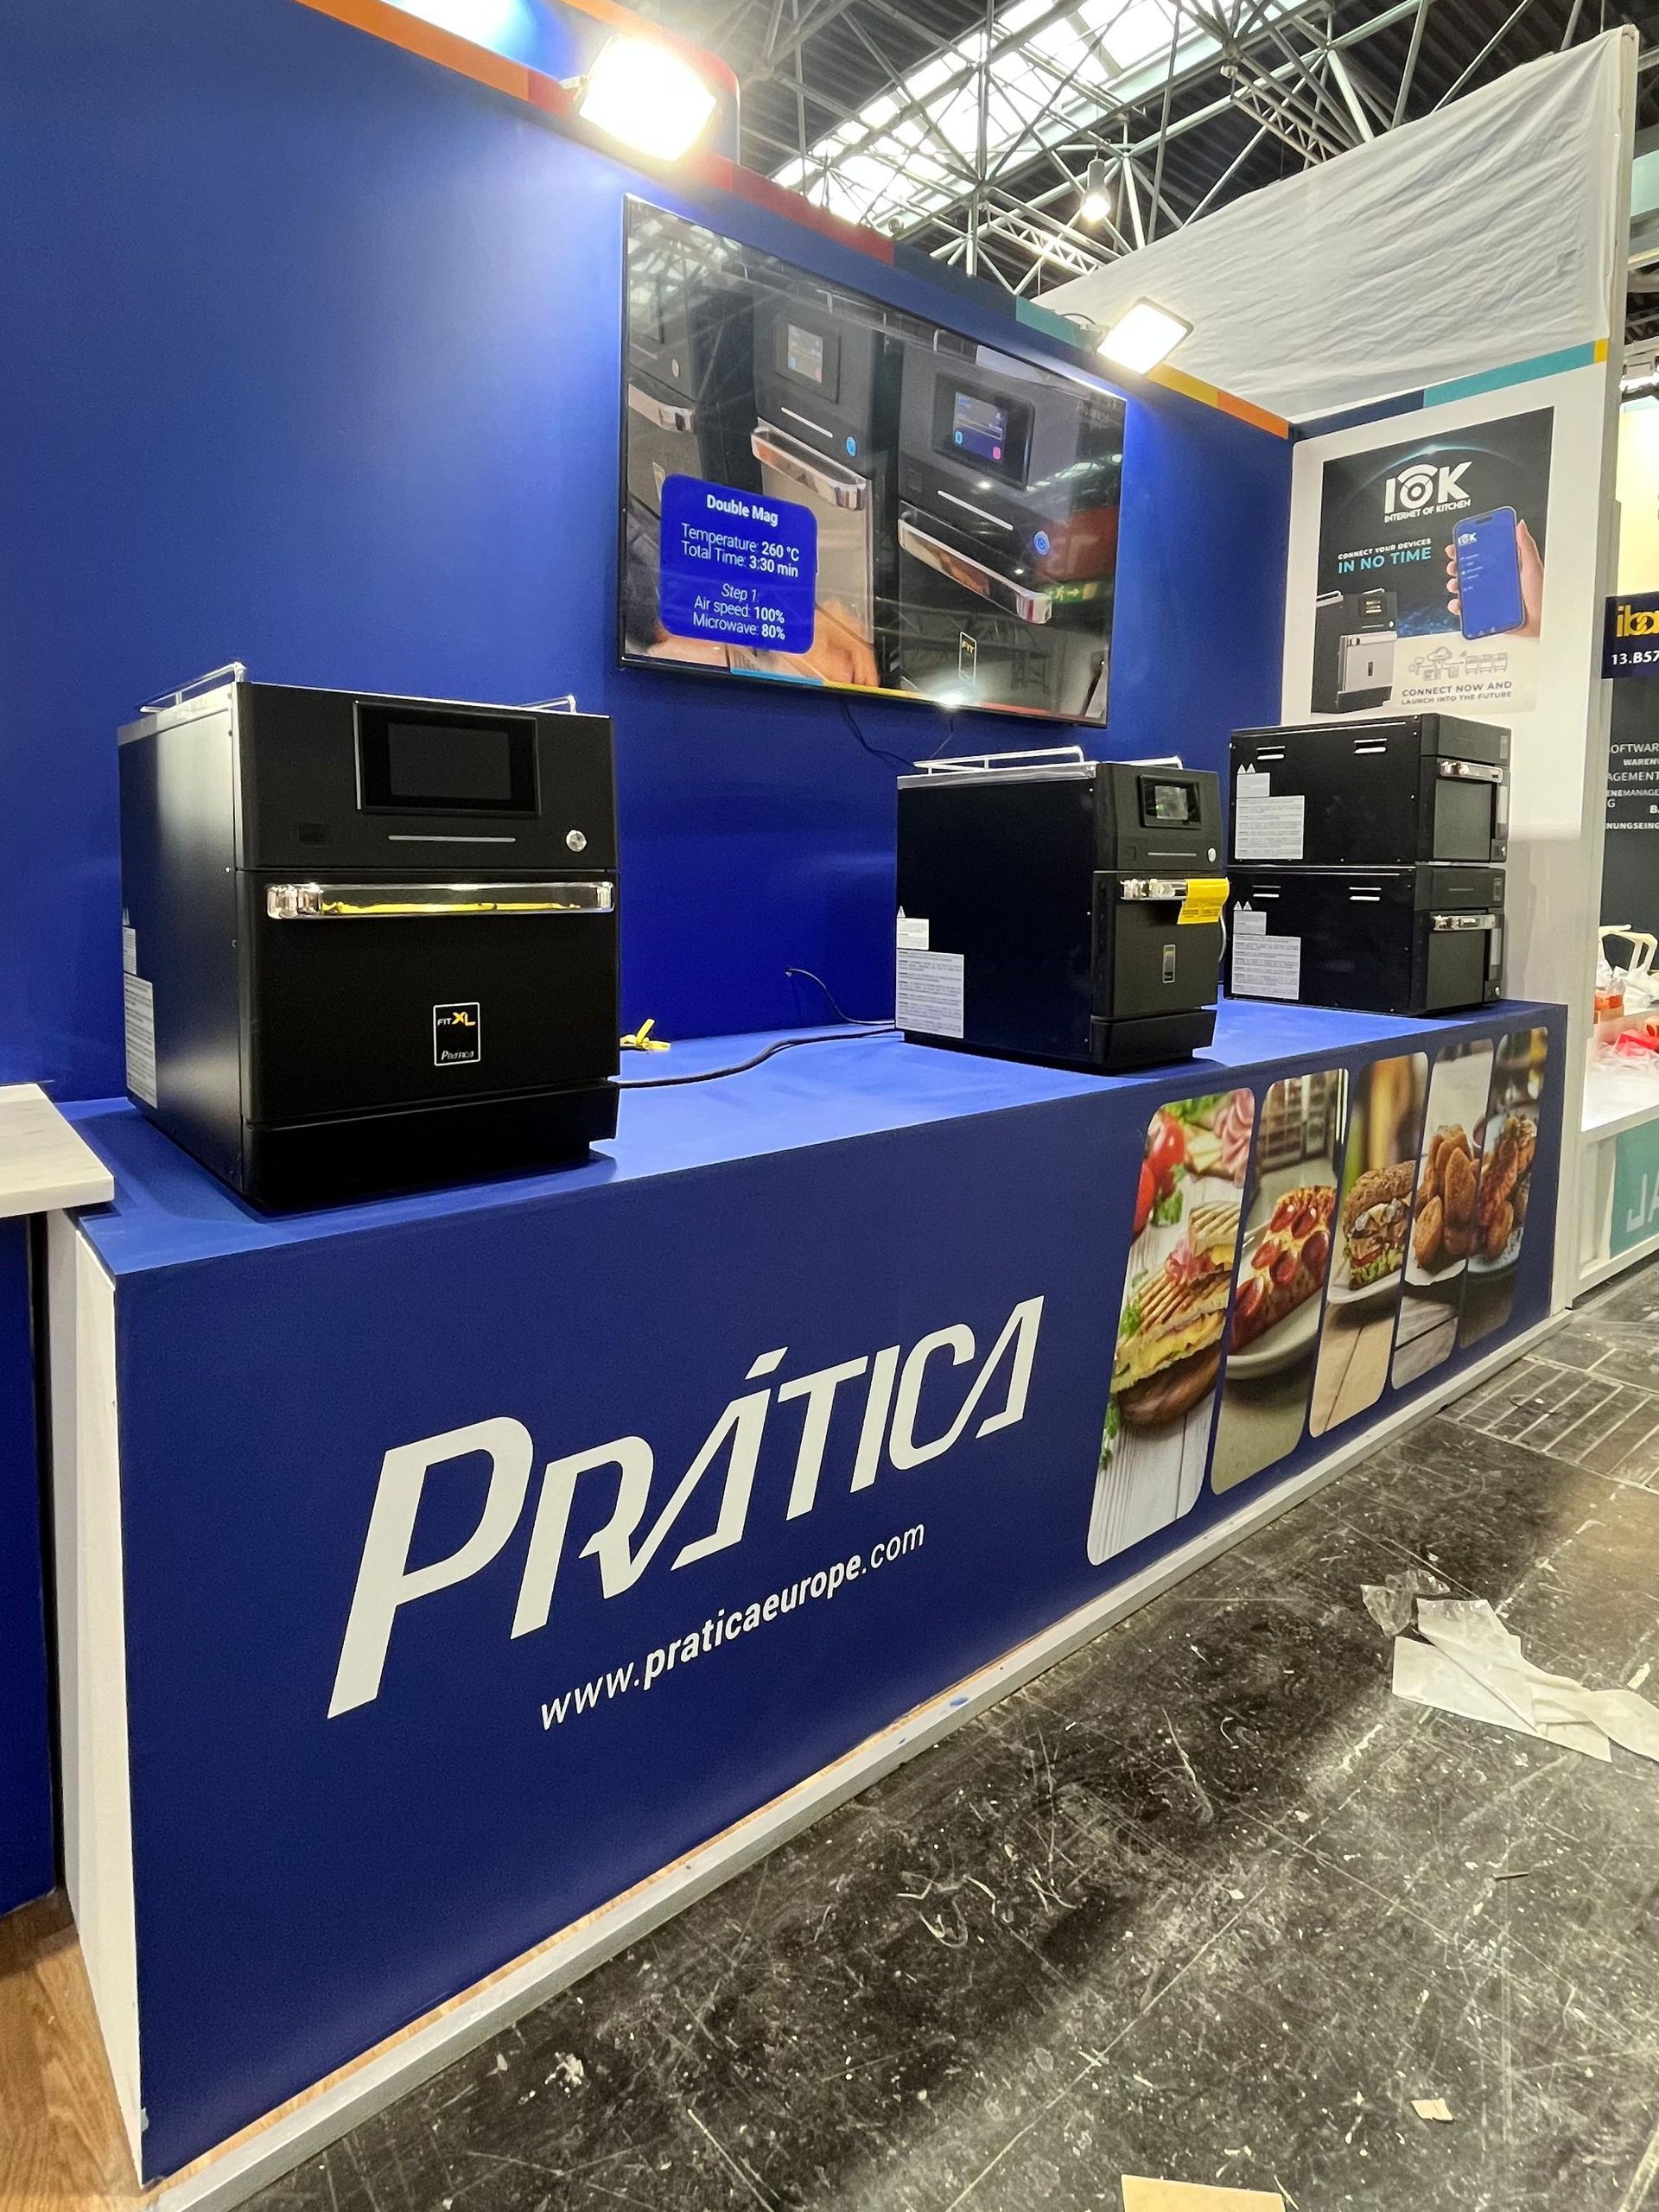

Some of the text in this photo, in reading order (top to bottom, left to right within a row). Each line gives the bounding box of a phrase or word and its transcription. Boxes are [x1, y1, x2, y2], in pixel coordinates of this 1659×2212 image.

[1384, 461, 1472, 514] IOK
[706, 494, 778, 527] Double Mag
[1384, 499, 1471, 524] INTERNET OF KITCHEN
[681, 522, 800, 562] Temperature: 260 °C
[1338, 537, 1432, 561] CONNECT YOUR DEVICES
[681, 540, 798, 578] Total Time: 3:30 min
[1338, 547, 1432, 574] IN NO TIME
[721, 583, 748, 602] Step
[694, 595, 710, 611] Air
[754, 607, 785, 624] 100%
[693, 612, 786, 639] Microwave: 80%
[1401, 696, 1434, 705] LAUNCH
[1478, 690, 1512, 700] FUTURE
[1402, 681, 1513, 697] CONNECT NOW AND
[540, 1522, 925, 1731] www.praticaeurope.com
